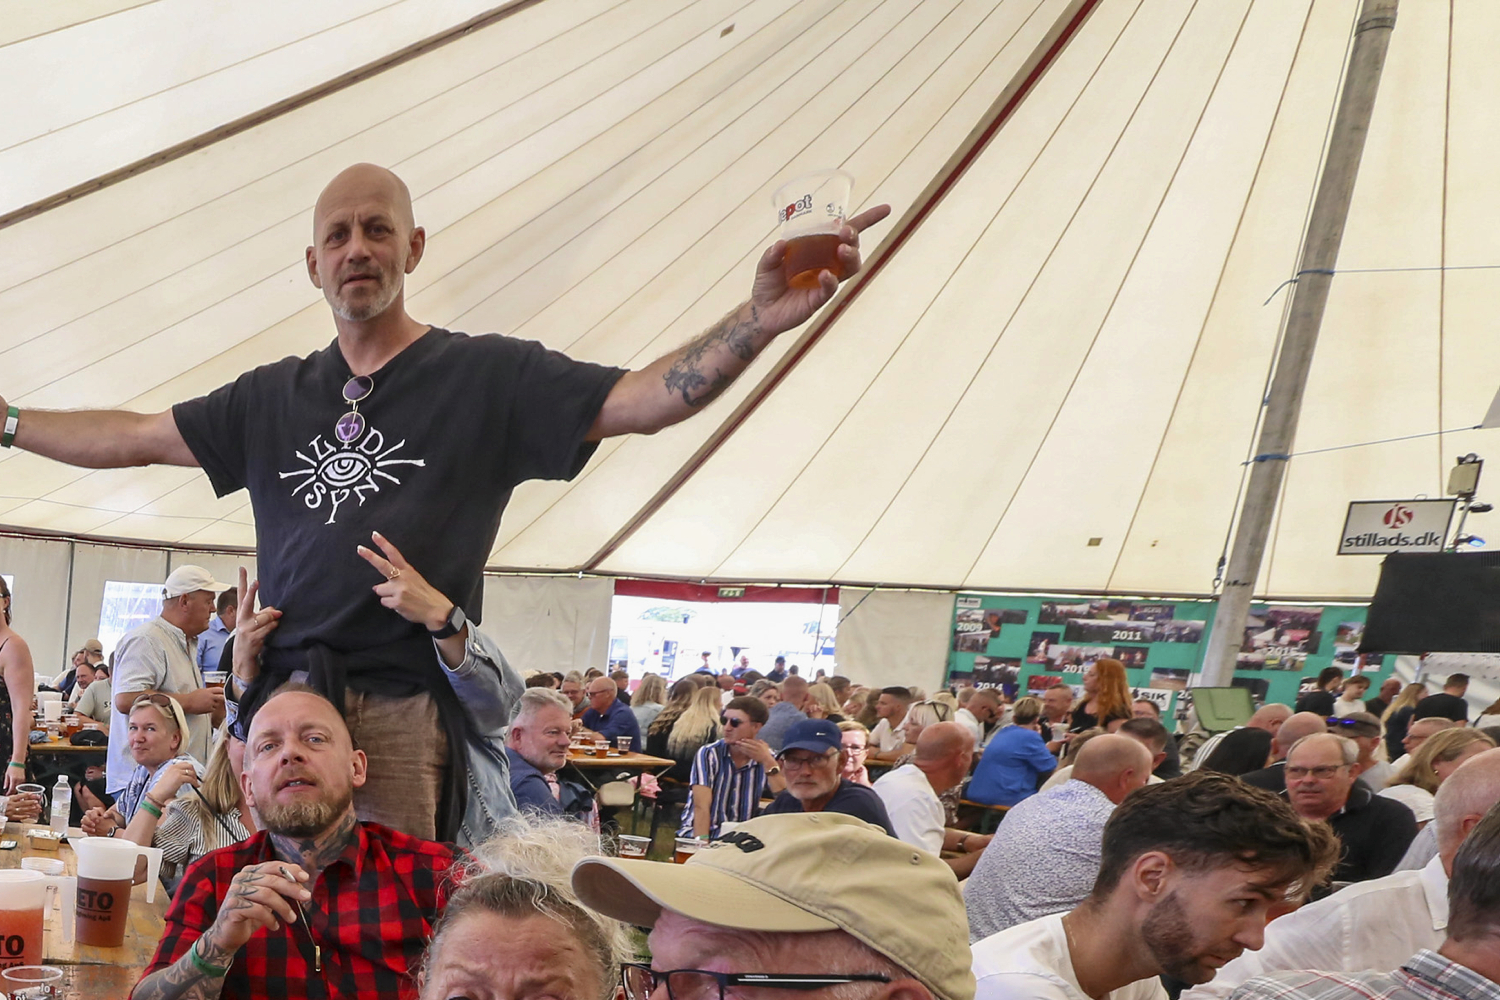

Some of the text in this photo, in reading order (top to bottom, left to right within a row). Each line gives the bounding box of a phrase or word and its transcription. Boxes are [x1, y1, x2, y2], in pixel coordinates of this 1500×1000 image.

[778, 194, 813, 225] epot
[309, 422, 384, 460] LYD
[305, 472, 380, 525] SYN
[1344, 532, 1441, 547] stillads.dk
[957, 622, 983, 633] 2009
[1112, 630, 1142, 641] 2011
[77, 887, 113, 910] ETO
